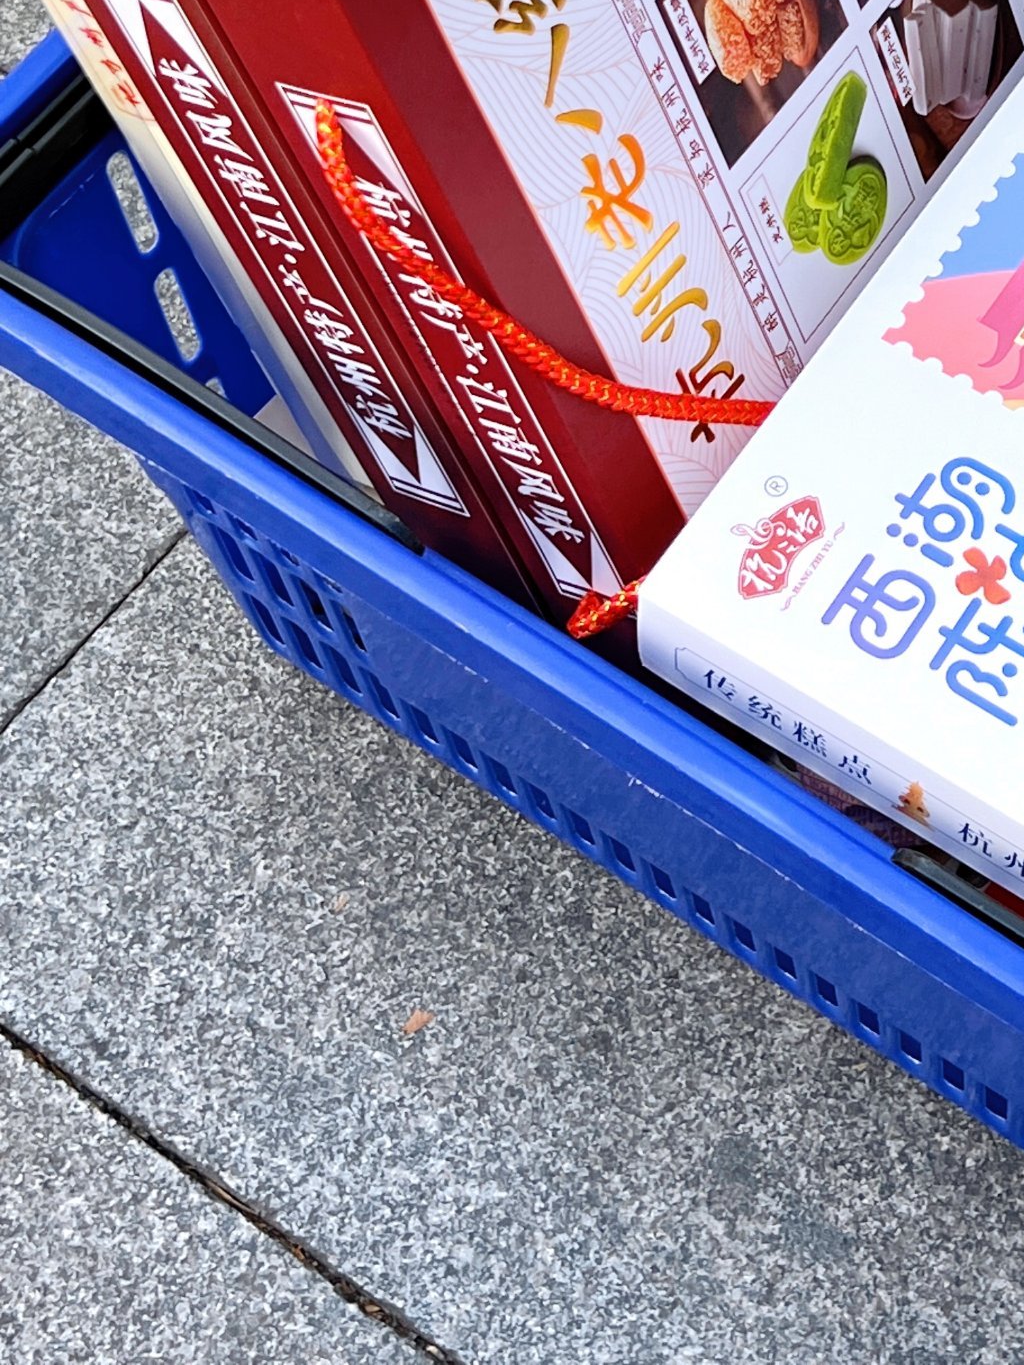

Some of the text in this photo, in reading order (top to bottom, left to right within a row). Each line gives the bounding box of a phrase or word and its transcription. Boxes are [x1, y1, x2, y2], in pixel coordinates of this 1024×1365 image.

[159, 56, 413, 437] 杭州特产·江南风味
[821, 455, 1017, 661] 西湖
